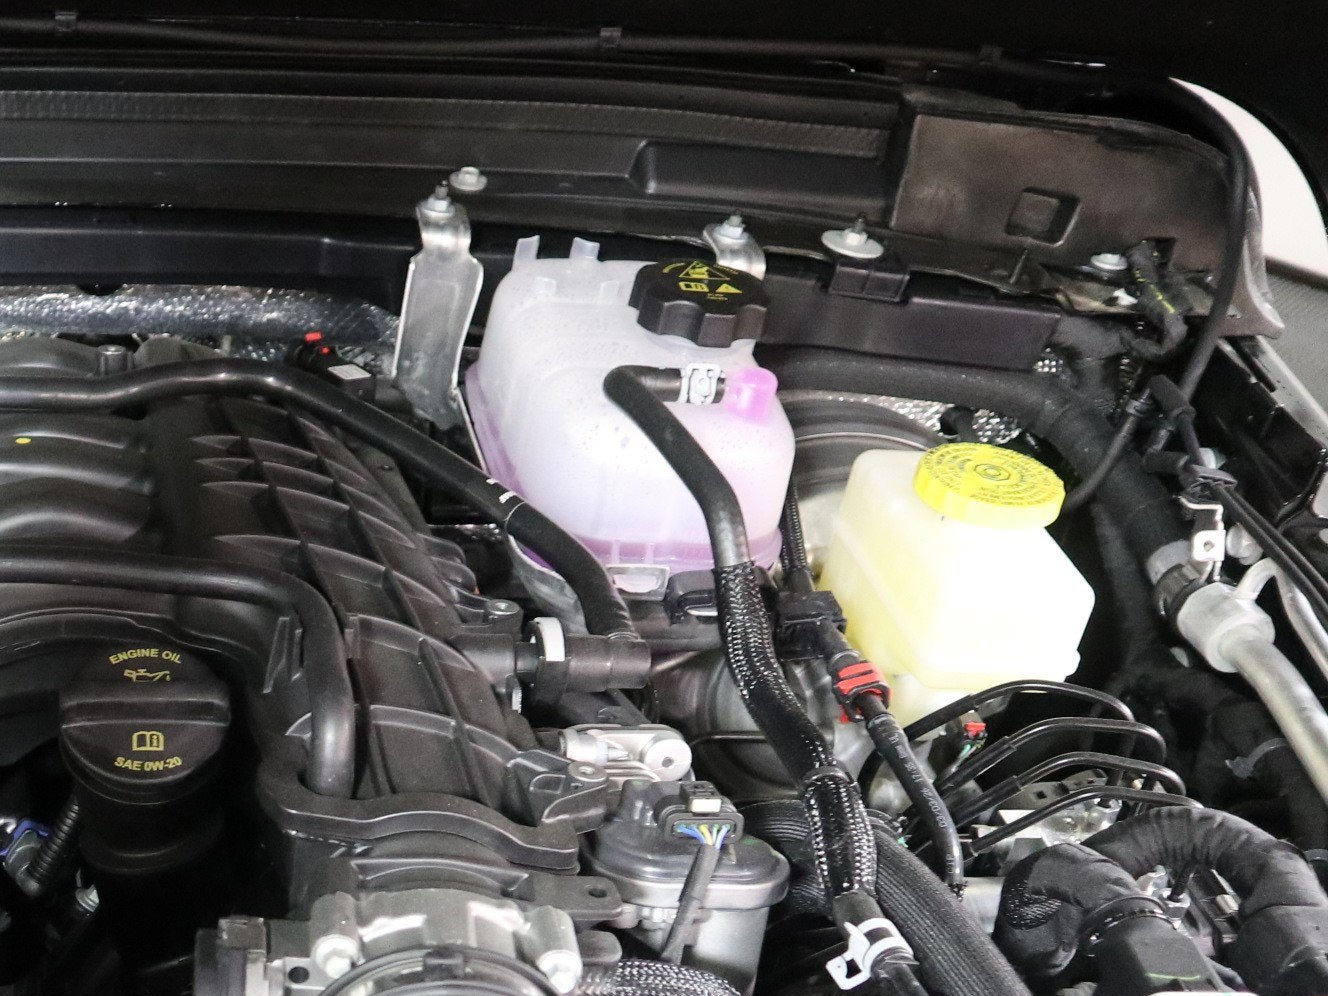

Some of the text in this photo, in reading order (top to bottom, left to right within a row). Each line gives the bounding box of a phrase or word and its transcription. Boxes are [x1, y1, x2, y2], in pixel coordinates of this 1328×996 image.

[109, 648, 182, 665] ENGINE OIL
[114, 756, 183, 771] SAE 0W-20
